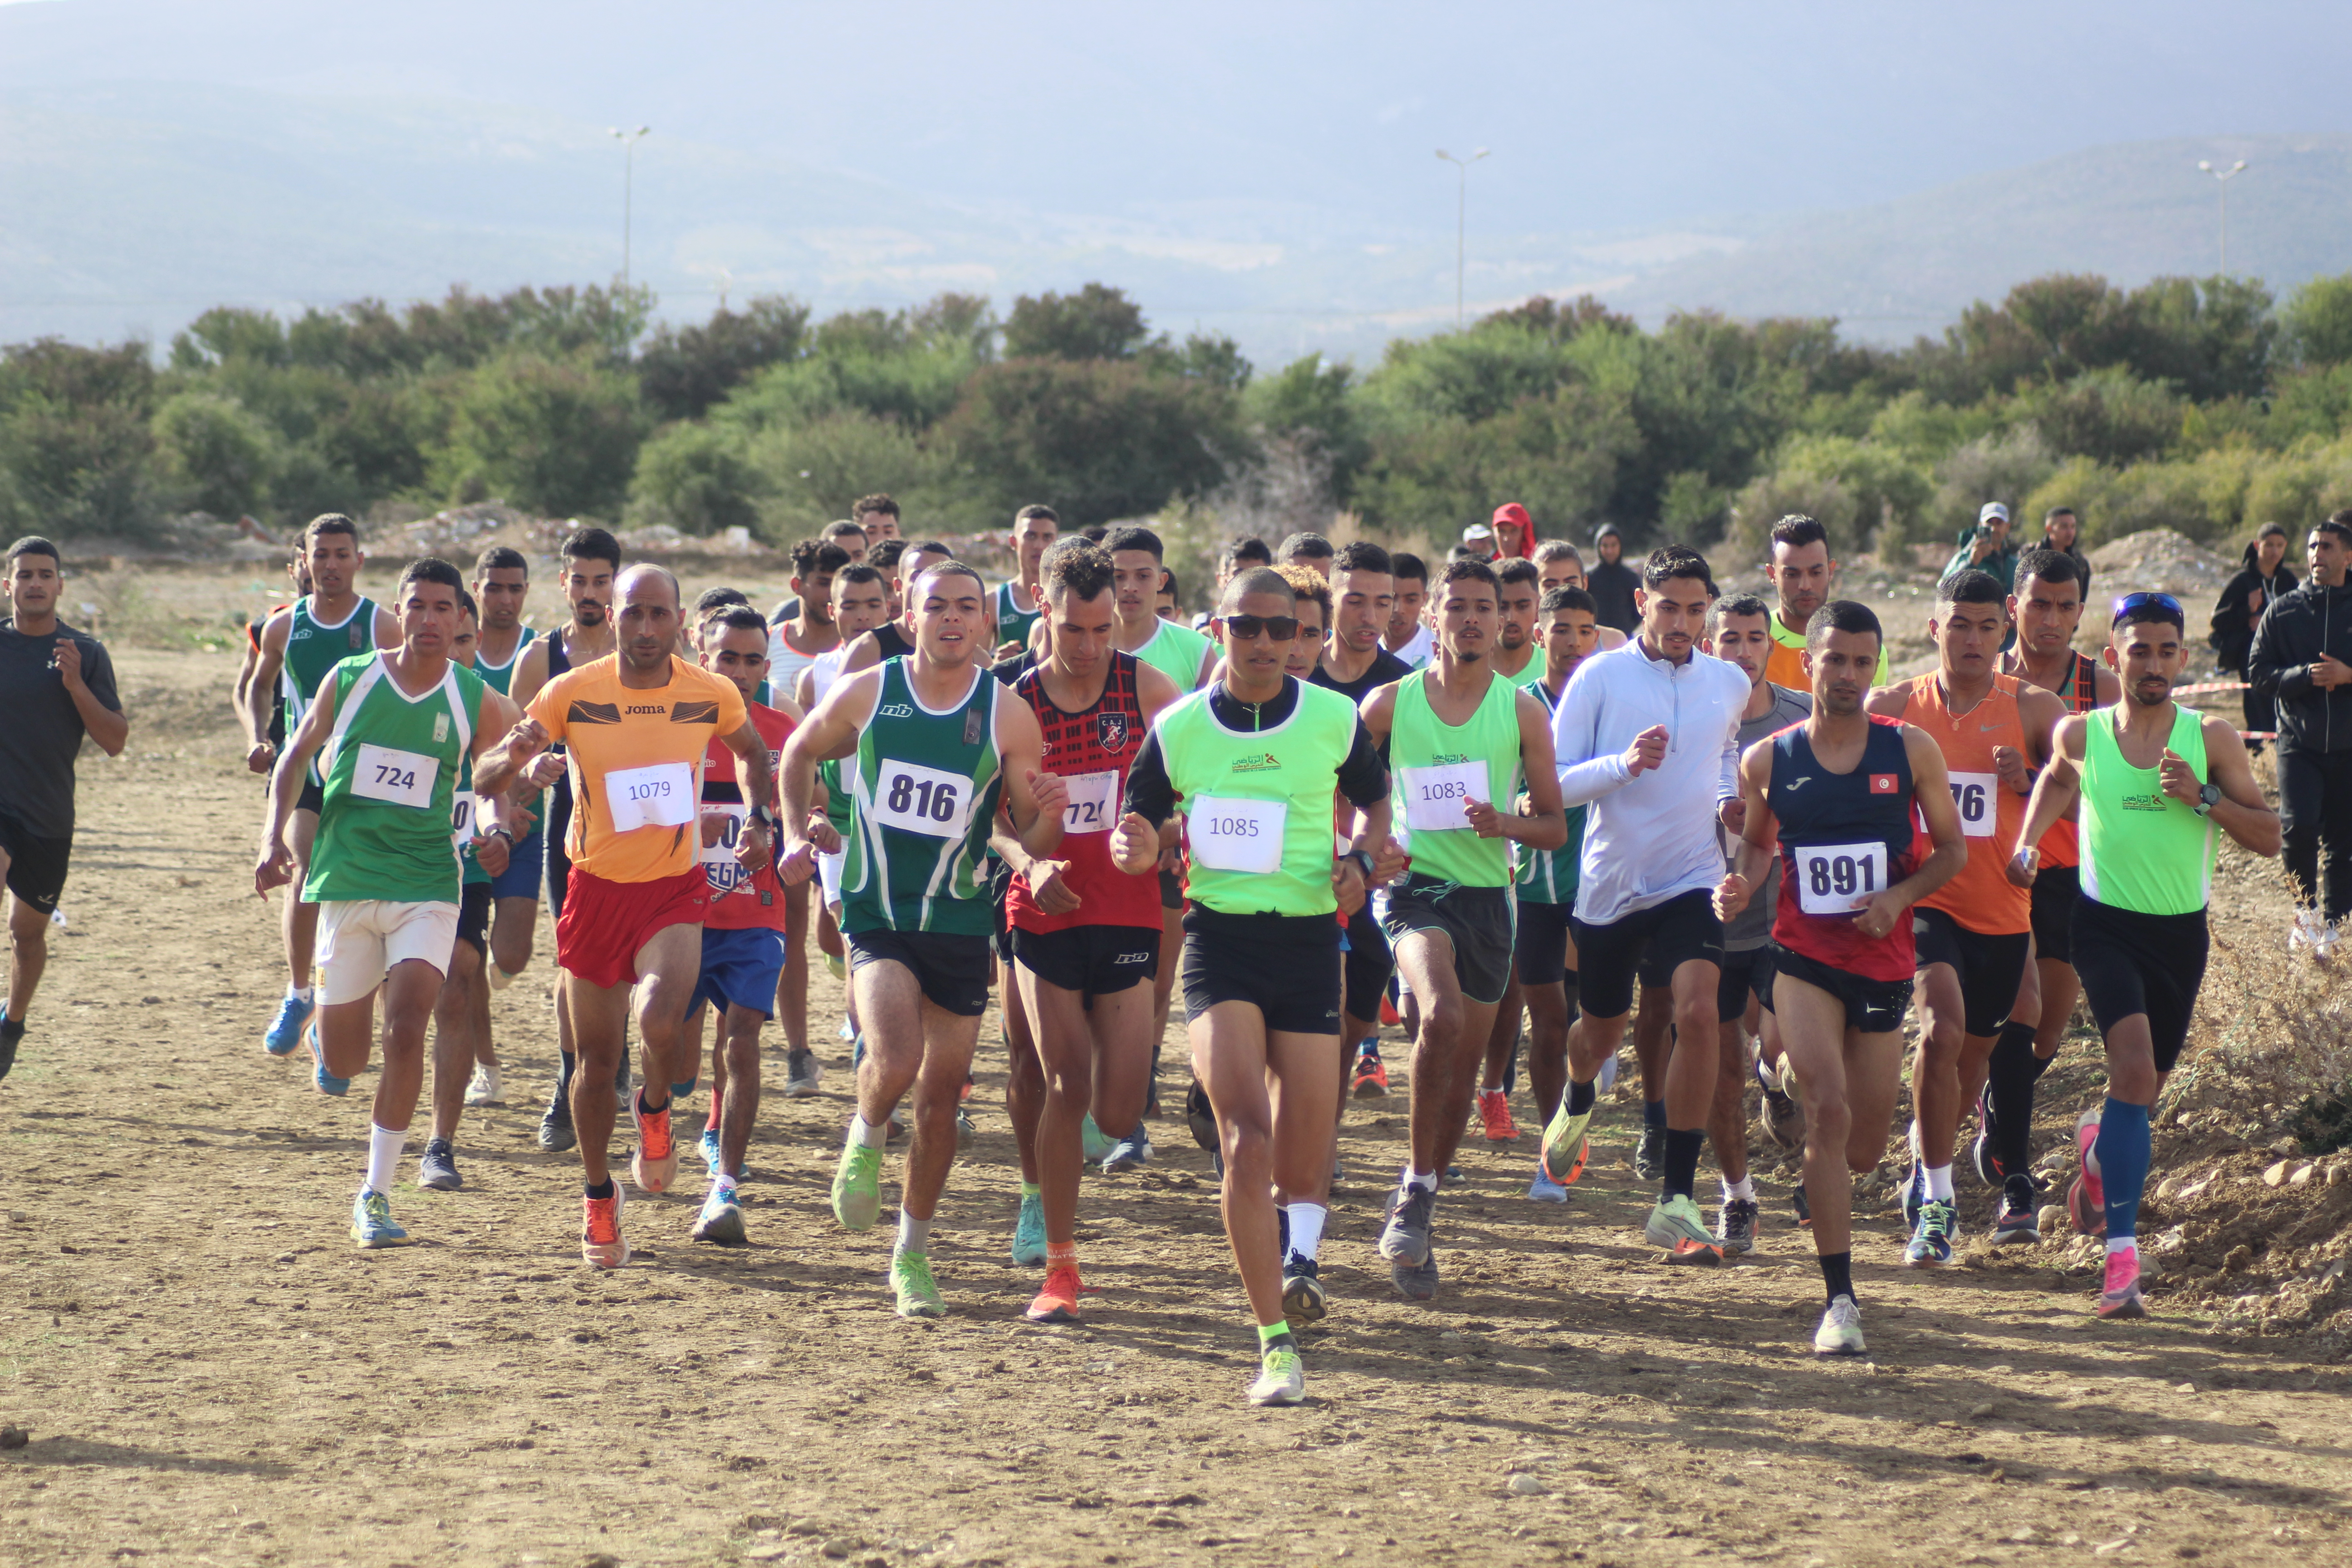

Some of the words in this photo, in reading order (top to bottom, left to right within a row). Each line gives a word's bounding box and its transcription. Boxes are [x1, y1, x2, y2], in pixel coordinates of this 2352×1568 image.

[879, 704, 913, 718] nb
[375, 764, 415, 789] 724
[629, 781, 670, 800] 1079
[888, 774, 957, 822] 816
[1422, 781, 1466, 800] 1083
[1950, 783, 1985, 822] 76
[1067, 800, 1105, 824] 72
[1210, 818, 1259, 837] 1085
[1809, 854, 1874, 896] 891
